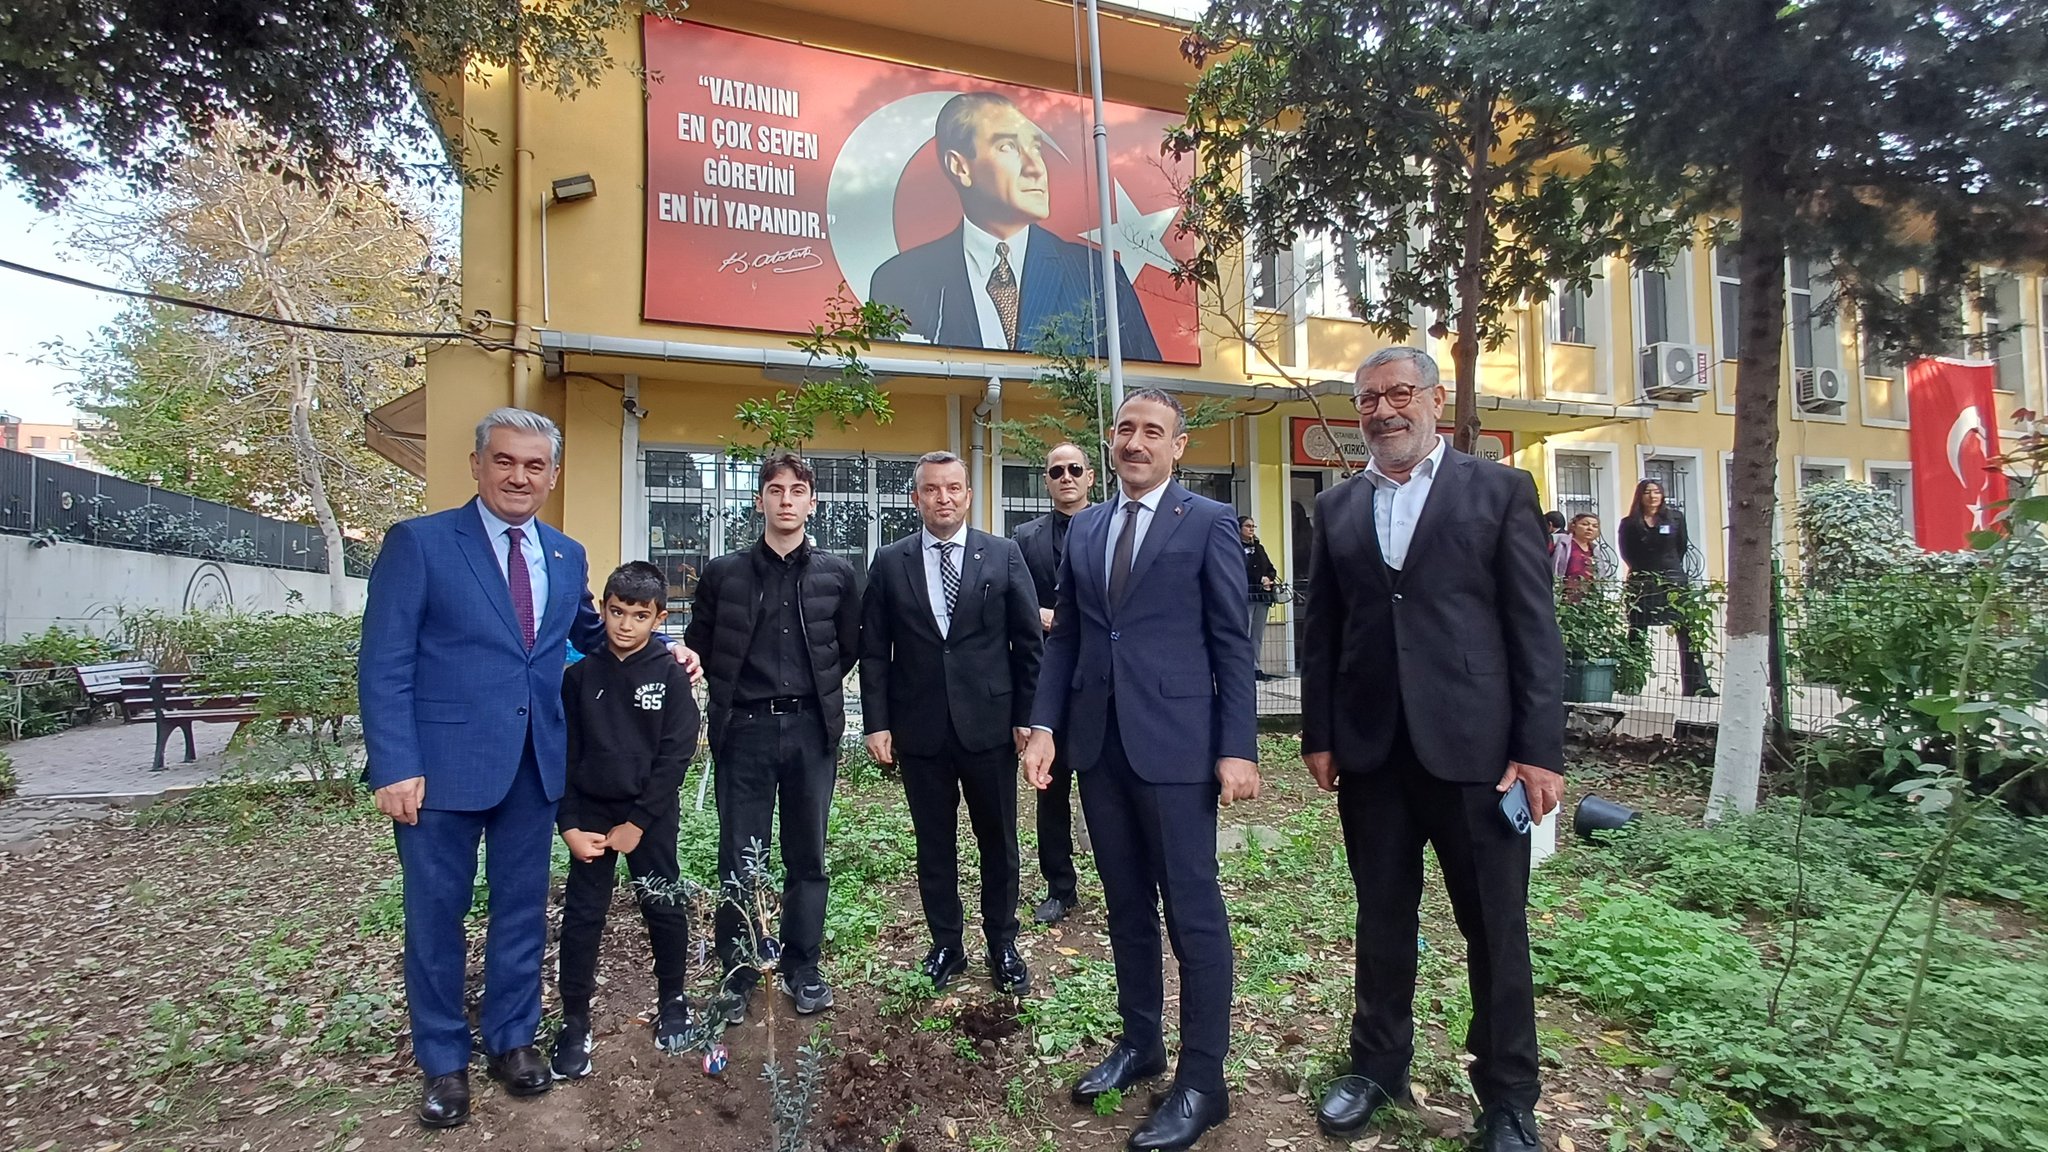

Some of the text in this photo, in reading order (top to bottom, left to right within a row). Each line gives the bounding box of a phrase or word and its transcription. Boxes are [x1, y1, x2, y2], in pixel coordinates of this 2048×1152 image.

[698, 75, 799, 119] “VATANINI
[678, 112, 818, 160] EN ÇOK SEVEN
[704, 154, 795, 196] GÖREVİNİ
[658, 191, 836, 240] EN İYİ YAPANDIR.”
[641, 693, 663, 710] 65
